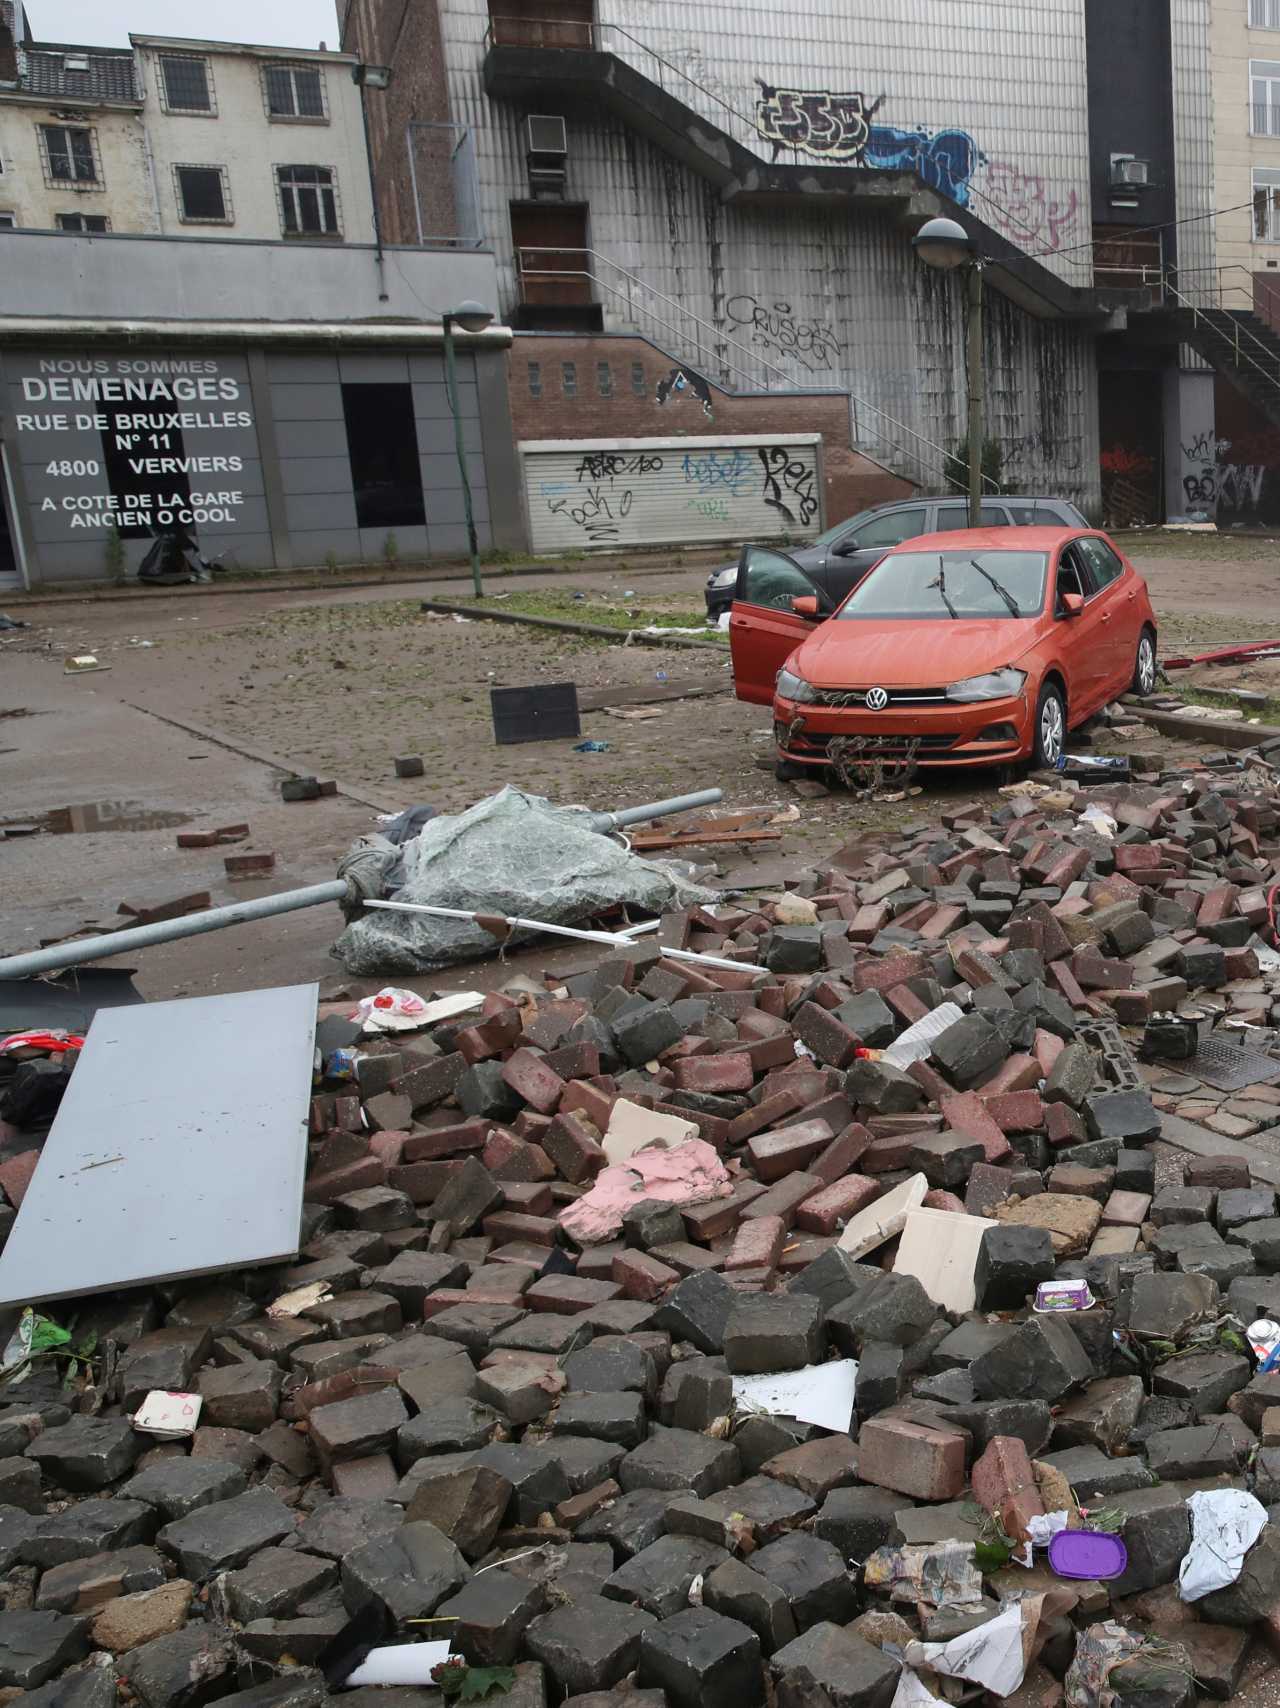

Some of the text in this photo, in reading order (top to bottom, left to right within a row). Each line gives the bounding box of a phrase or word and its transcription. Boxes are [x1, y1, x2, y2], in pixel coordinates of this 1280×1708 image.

[39, 360, 218, 374] NOUS SOMMES
[22, 377, 240, 401] DEMENAGES
[16, 411, 252, 431] RUE DE BRUXELLES
[149, 434, 171, 449] 11
[46, 456, 243, 476] 4800 VERVIERS
[41, 491, 244, 511] A COTE DE LA GARE
[70, 508, 236, 528] ANCIEN O COOL
